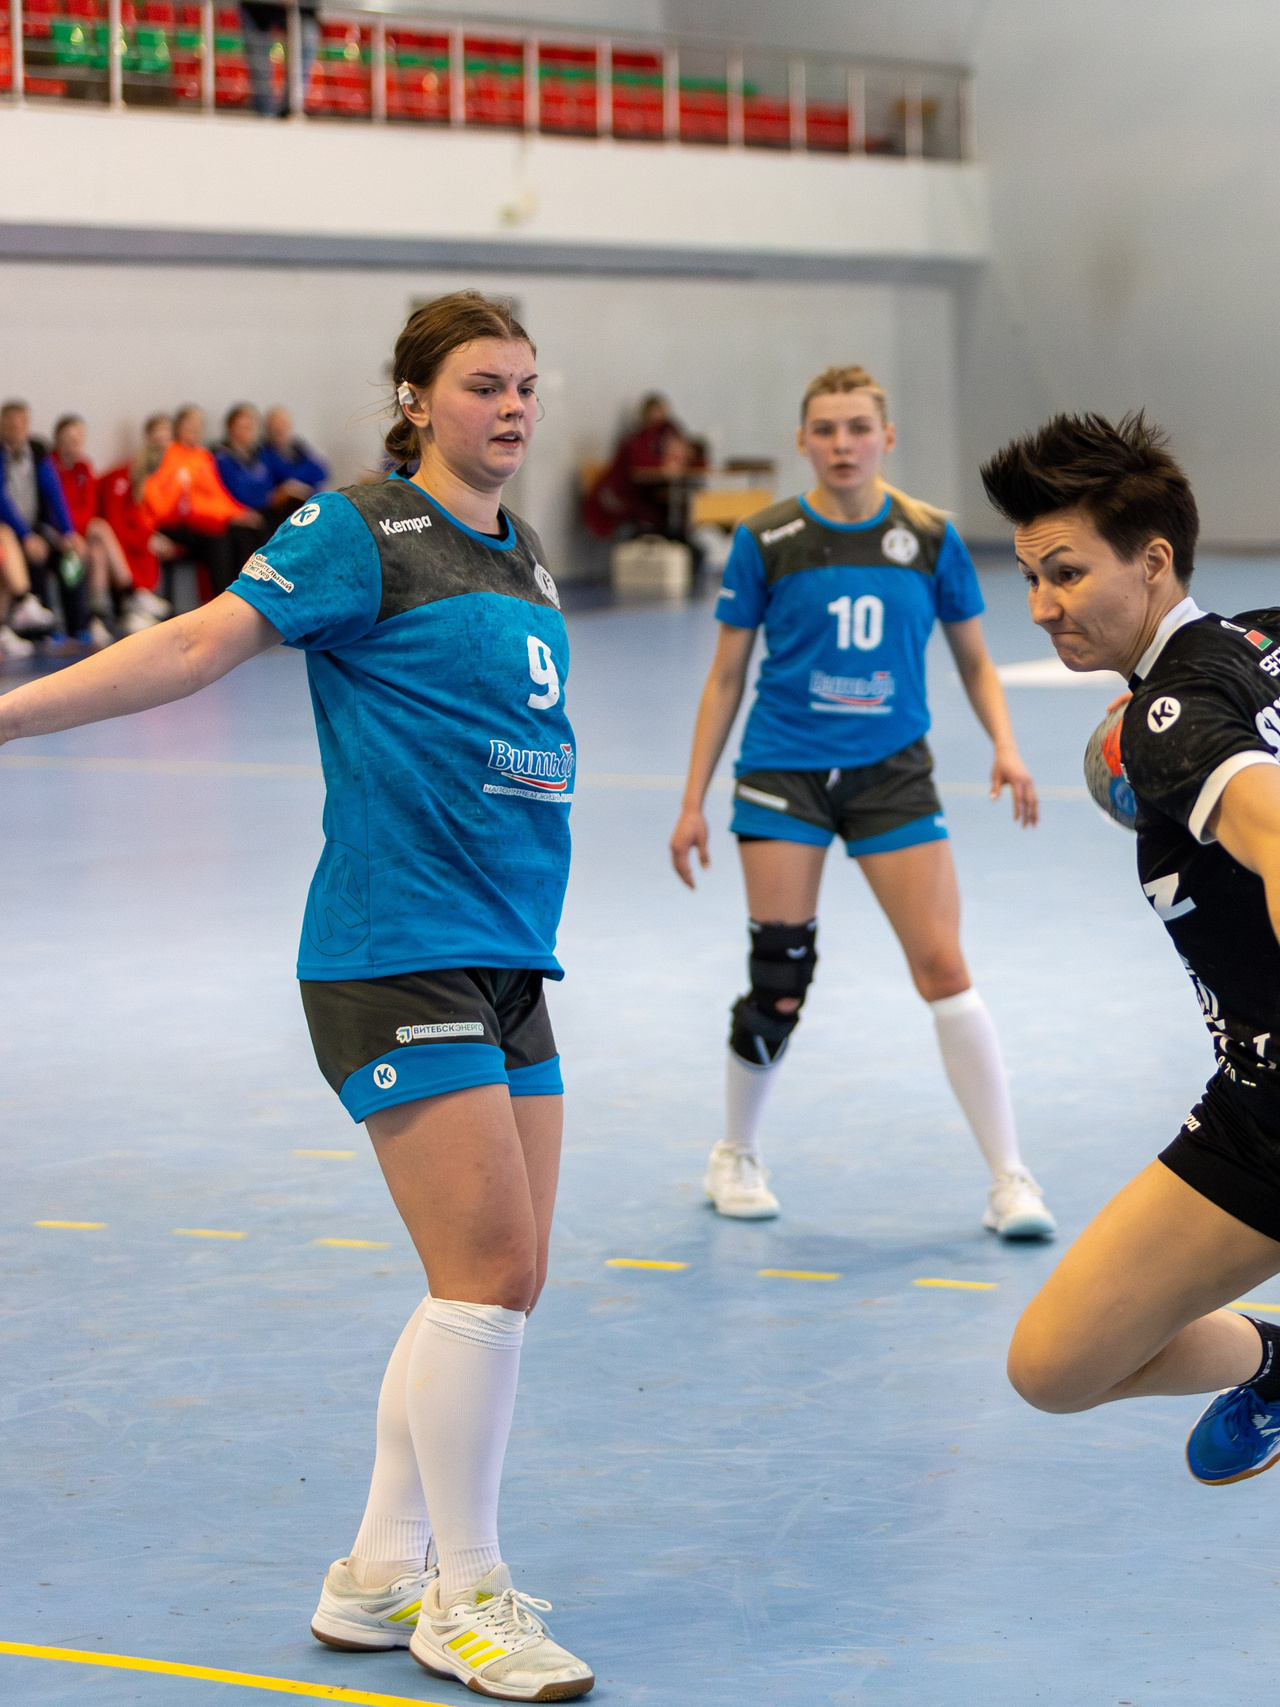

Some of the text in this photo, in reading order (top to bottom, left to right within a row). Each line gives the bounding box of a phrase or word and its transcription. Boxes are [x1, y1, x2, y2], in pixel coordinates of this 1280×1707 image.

[379, 515, 432, 535] Kempa
[827, 595, 885, 651] 10
[526, 635, 560, 710] 9
